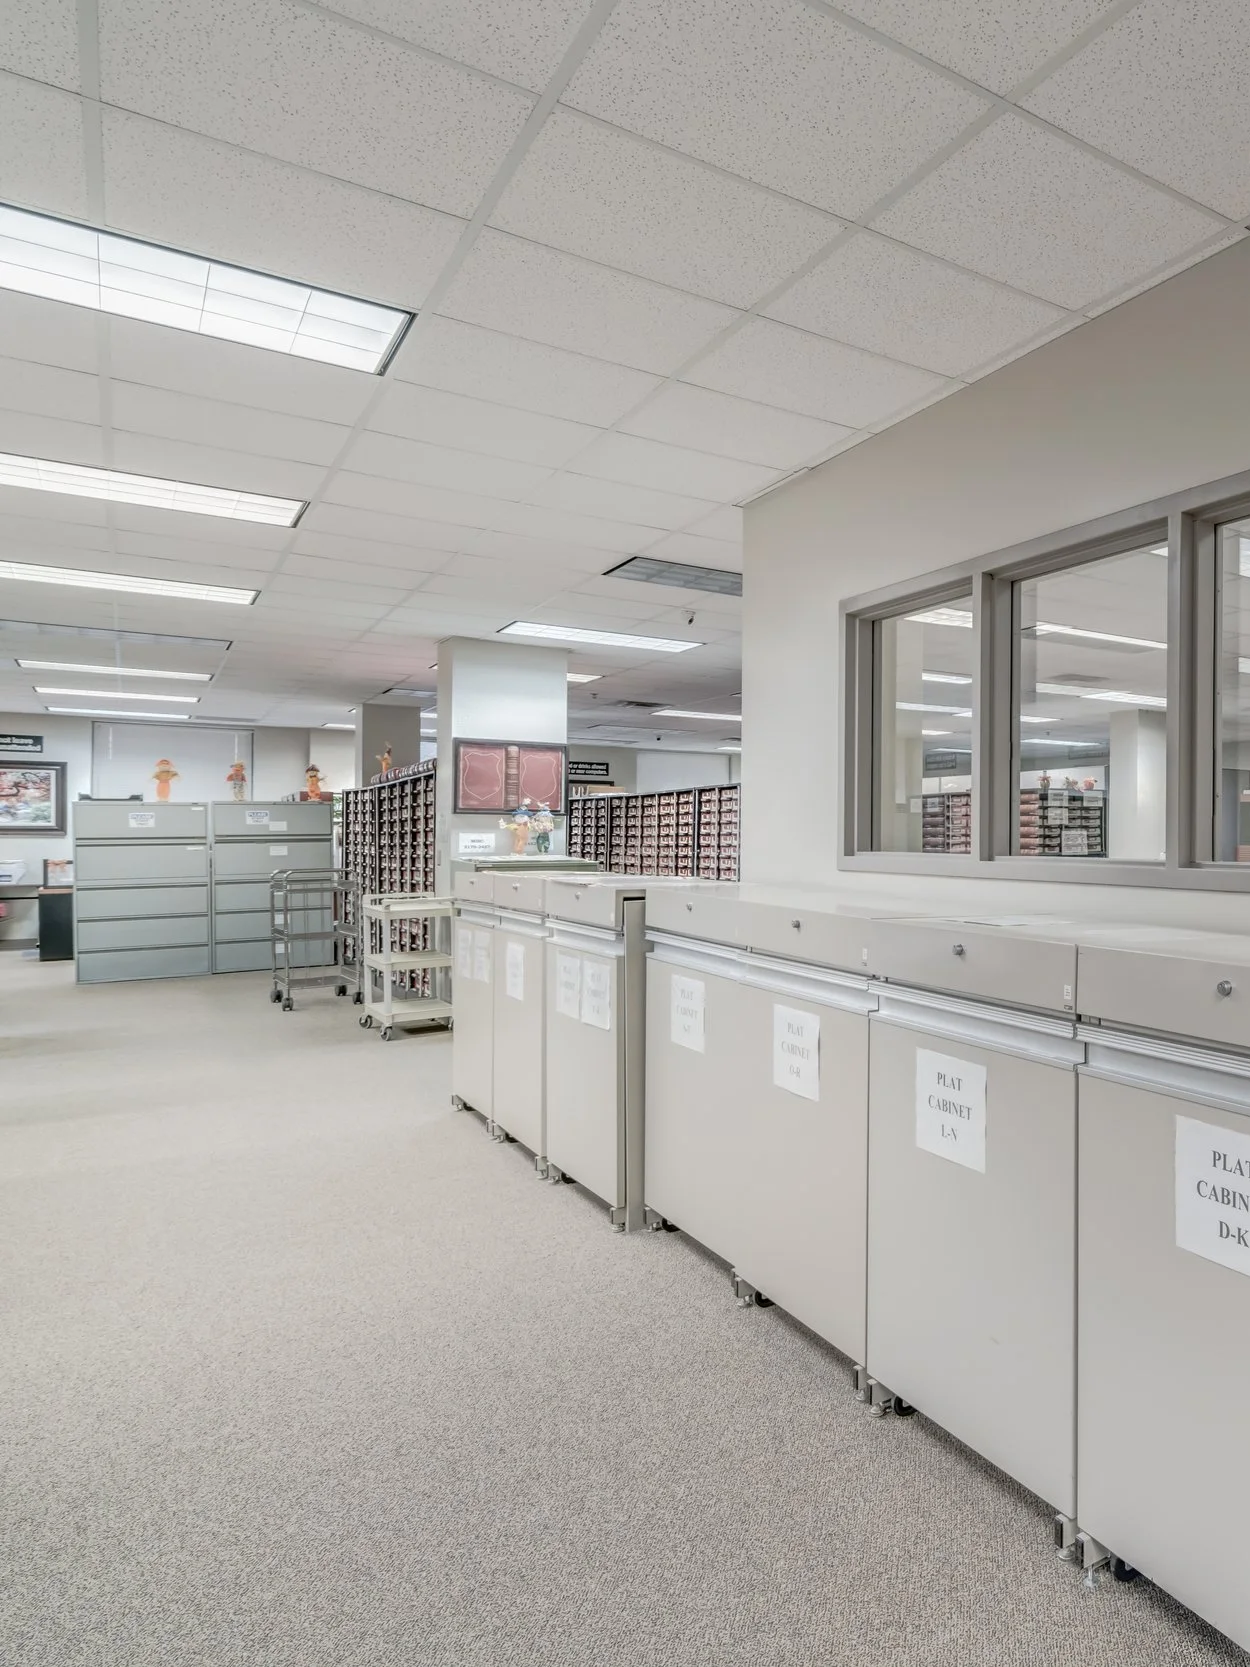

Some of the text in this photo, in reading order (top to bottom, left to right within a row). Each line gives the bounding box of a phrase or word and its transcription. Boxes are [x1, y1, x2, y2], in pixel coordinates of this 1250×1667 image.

[787, 1022, 804, 1037] PLAT
[781, 1040, 810, 1060] CABINET
[937, 1072, 962, 1092] PLAT
[928, 1094, 972, 1121] CABINET
[941, 1124, 958, 1141] L-N
[1218, 1220, 1249, 1248] D-K
